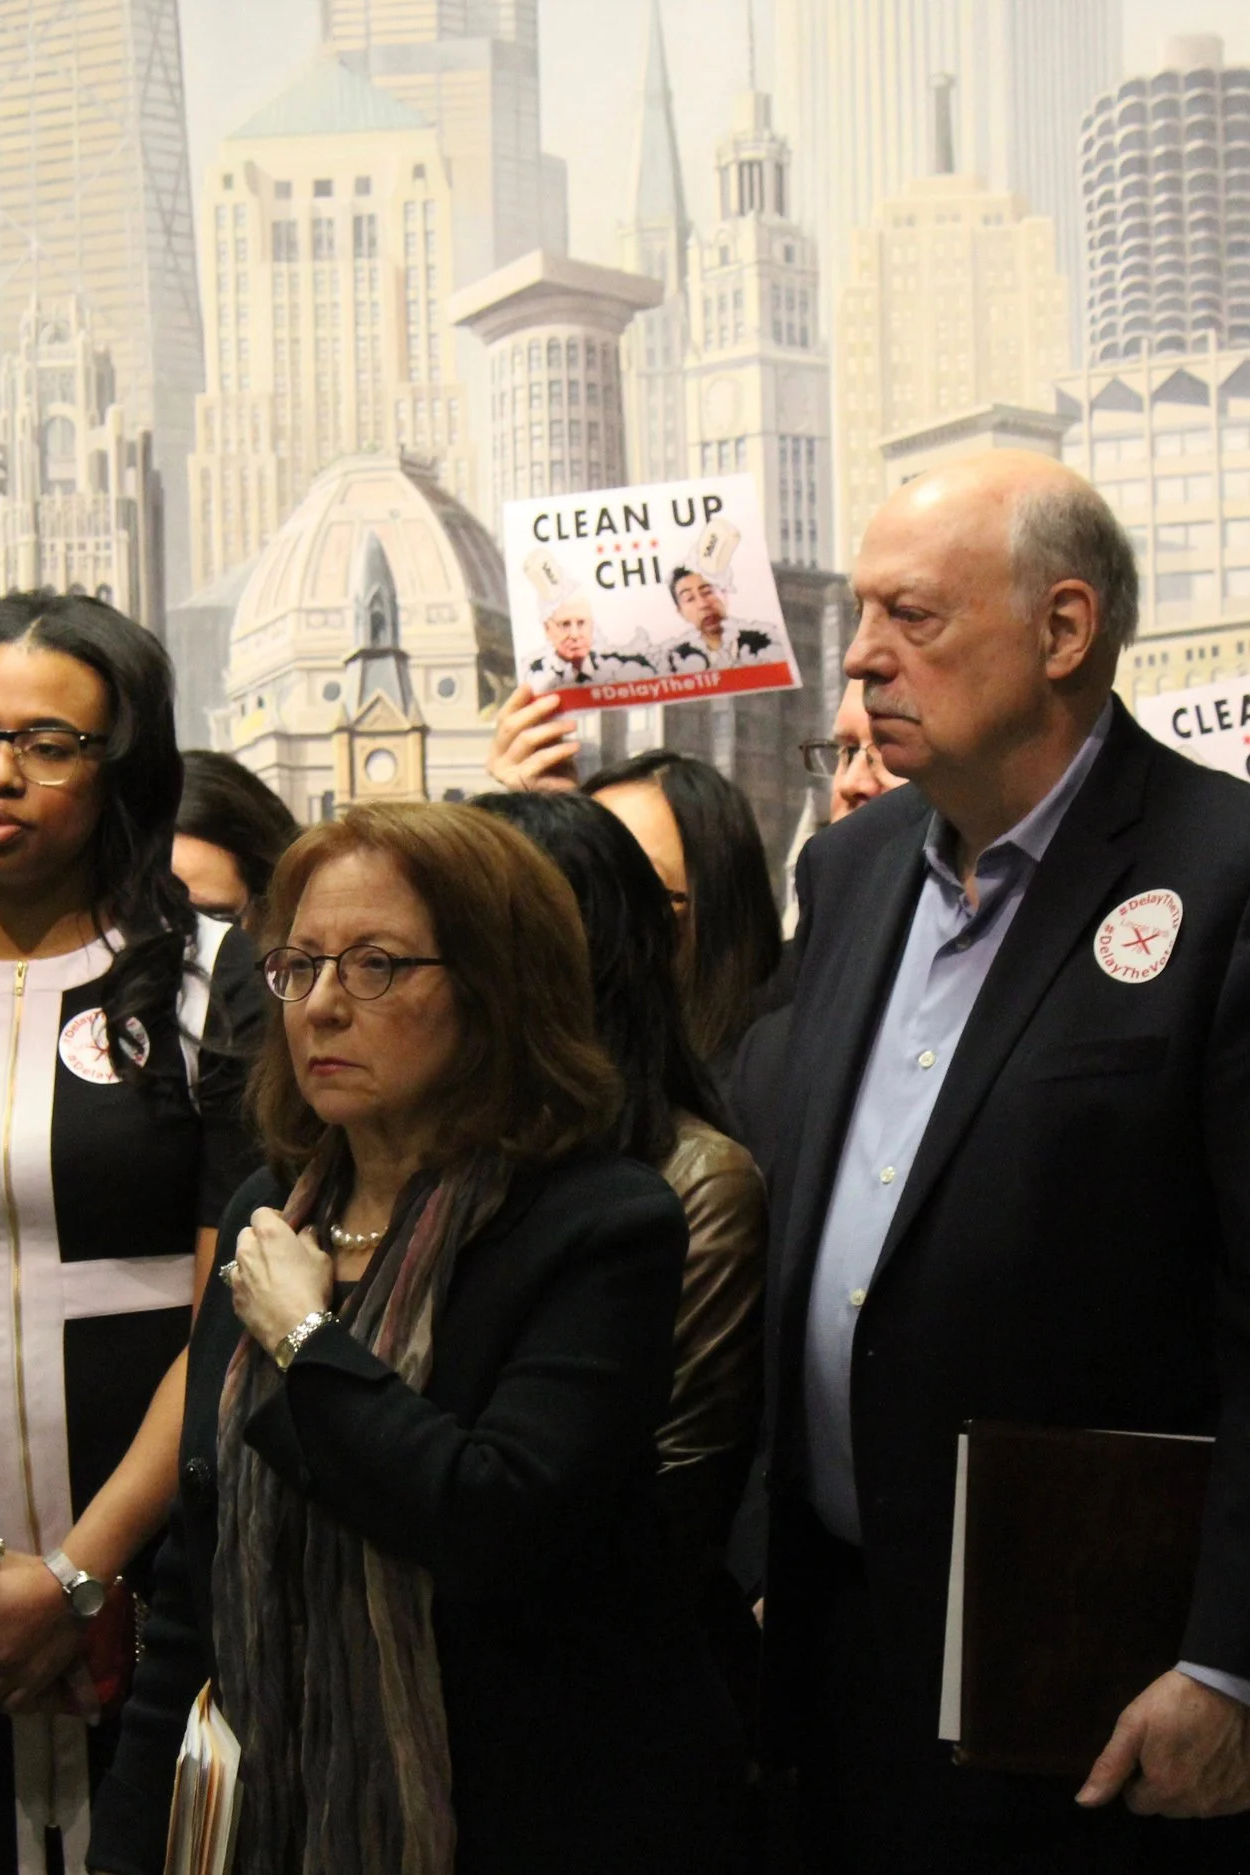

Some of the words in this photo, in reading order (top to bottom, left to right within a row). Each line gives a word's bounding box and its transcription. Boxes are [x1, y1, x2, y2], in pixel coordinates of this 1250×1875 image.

[533, 502, 651, 542] CLEAN
[671, 494, 724, 528] UP
[595, 556, 663, 590] CHI
[590, 674, 722, 701] #DelayTheTIF
